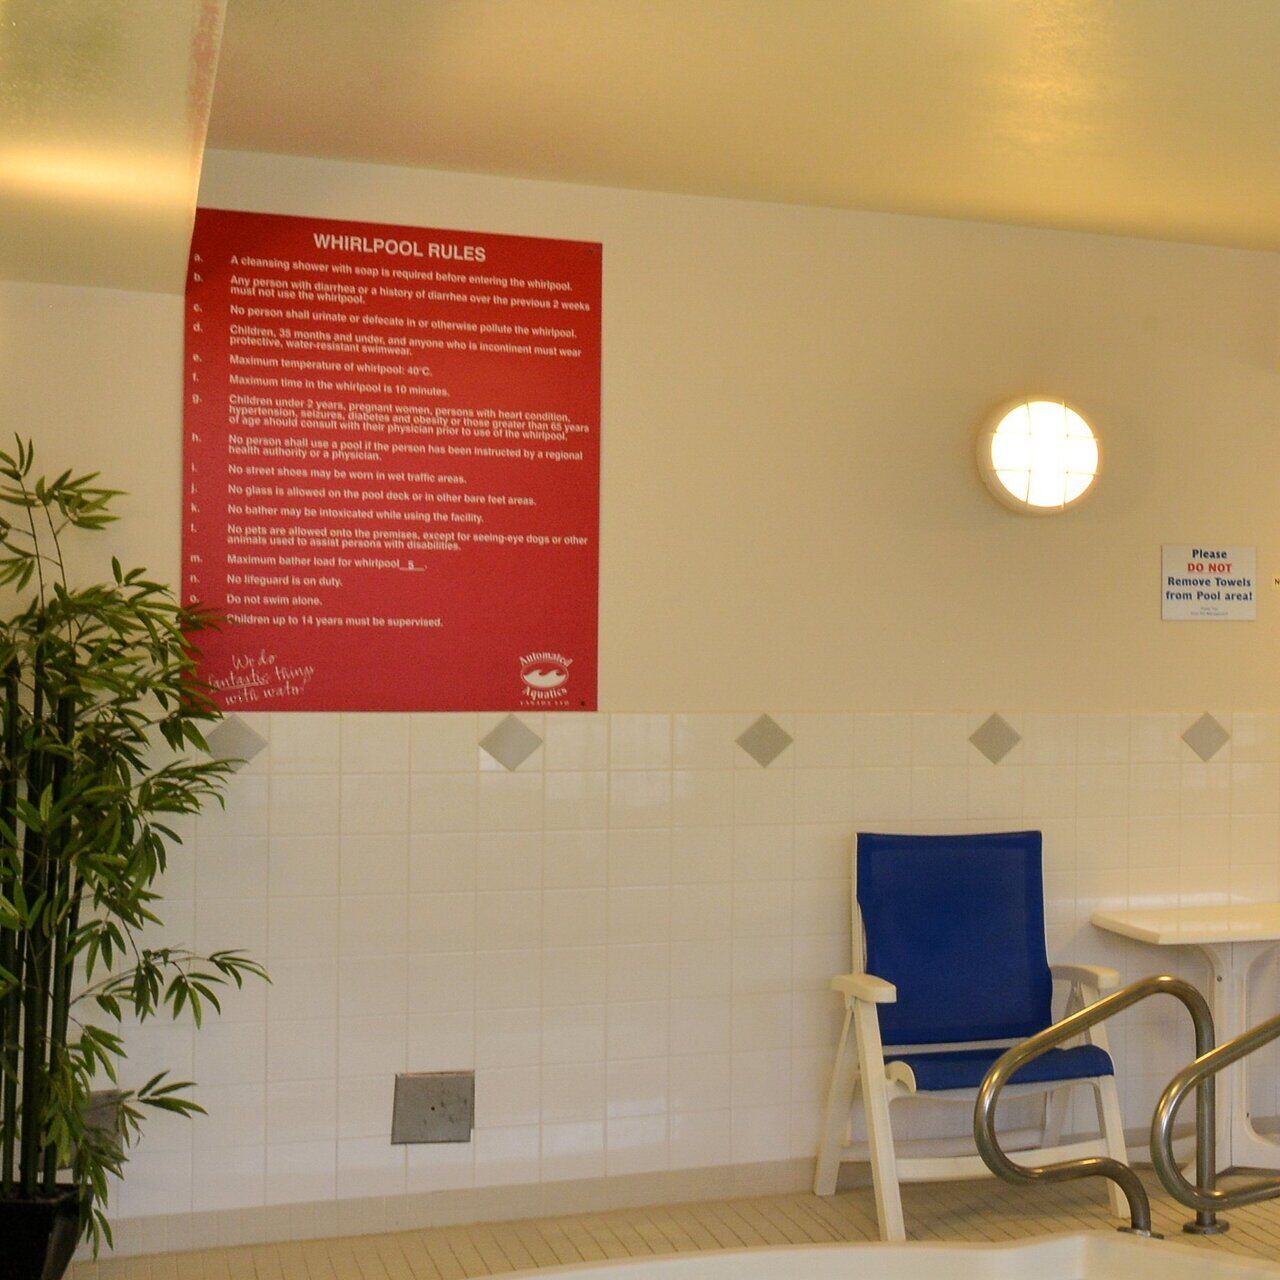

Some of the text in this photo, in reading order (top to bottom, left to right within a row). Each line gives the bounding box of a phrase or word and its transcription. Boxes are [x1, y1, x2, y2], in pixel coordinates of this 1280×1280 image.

[312, 233, 487, 262] WHIRLPOOL RULES
[230, 254, 238, 264] A
[240, 255, 290, 271] cleansing
[292, 259, 328, 271] shower
[331, 262, 352, 273] with
[354, 266, 379, 278] soap
[380, 266, 390, 276] is
[391, 266, 433, 282] required
[435, 270, 466, 282] before
[468, 272, 508, 288] entering
[509, 276, 525, 287] the
[230, 274, 591, 311] Any person with diarrhea or a history of diarrhea over the previous 2 weeks
[230, 304, 245, 315] No
[247, 308, 283, 320] person
[285, 308, 309, 320] shall
[311, 310, 346, 322] urinate
[348, 315, 359, 323] or
[361, 313, 404, 326] defecate
[406, 316, 416, 327] in
[417, 319, 428, 328] or
[430, 318, 477, 331] otherwise
[479, 321, 512, 336] pollute
[514, 323, 529, 334] the
[229, 354, 278, 367] Maximum
[280, 357, 341, 373] temperature
[343, 361, 354, 371] of
[229, 374, 278, 387] Maximum
[280, 377, 302, 388] time
[304, 378, 314, 389] in
[316, 379, 333, 390] the
[335, 380, 381, 395] whirlpool
[383, 382, 392, 393] is
[395, 383, 407, 394] 10
[228, 463, 243, 474] No
[245, 464, 274, 475] street
[276, 465, 307, 476] shoes
[309, 469, 331, 480] may
[333, 467, 346, 478] be
[348, 470, 373, 479] worn
[375, 469, 385, 479] in
[387, 469, 405, 480] wet
[406, 470, 435, 481] traffic
[228, 483, 243, 494] No
[244, 484, 272, 498] glass
[274, 485, 284, 496] is
[286, 486, 326, 497] allowed
[327, 489, 341, 498] on
[343, 488, 359, 498] the
[361, 488, 384, 502] pool
[385, 489, 409, 500] deck
[411, 493, 422, 501] or
[424, 491, 434, 501] in
[436, 491, 461, 502] other
[463, 492, 485, 503] bare
[227, 503, 242, 514] No
[244, 504, 277, 515] bather
[280, 507, 301, 518] may
[303, 506, 317, 516] be
[319, 506, 373, 518] intoxicated
[375, 508, 401, 519] while
[403, 509, 430, 522] using
[432, 510, 448, 520] the
[1192, 548, 1227, 559] Please
[227, 554, 276, 565] Maximum
[278, 555, 310, 566] bather
[313, 556, 335, 567] load
[337, 557, 351, 567] for
[354, 557, 400, 571] whirlpool
[1187, 563, 1232, 572] DO NOT
[226, 574, 241, 584] No
[243, 574, 289, 587] lifeguard
[291, 575, 301, 585] is
[302, 578, 316, 586] on
[1167, 576, 1251, 586] Remove Towels
[226, 594, 241, 604] Do
[243, 594, 260, 605] not
[262, 595, 289, 605] swim
[1166, 591, 1253, 600] from Pool area!
[272, 616, 285, 627] up
[287, 614, 298, 625] to
[302, 615, 313, 625] 14
[315, 617, 343, 628] years
[345, 615, 370, 625] must
[371, 615, 385, 626] be
[519, 652, 573, 667] Automated
[522, 686, 568, 700] Aquatics
